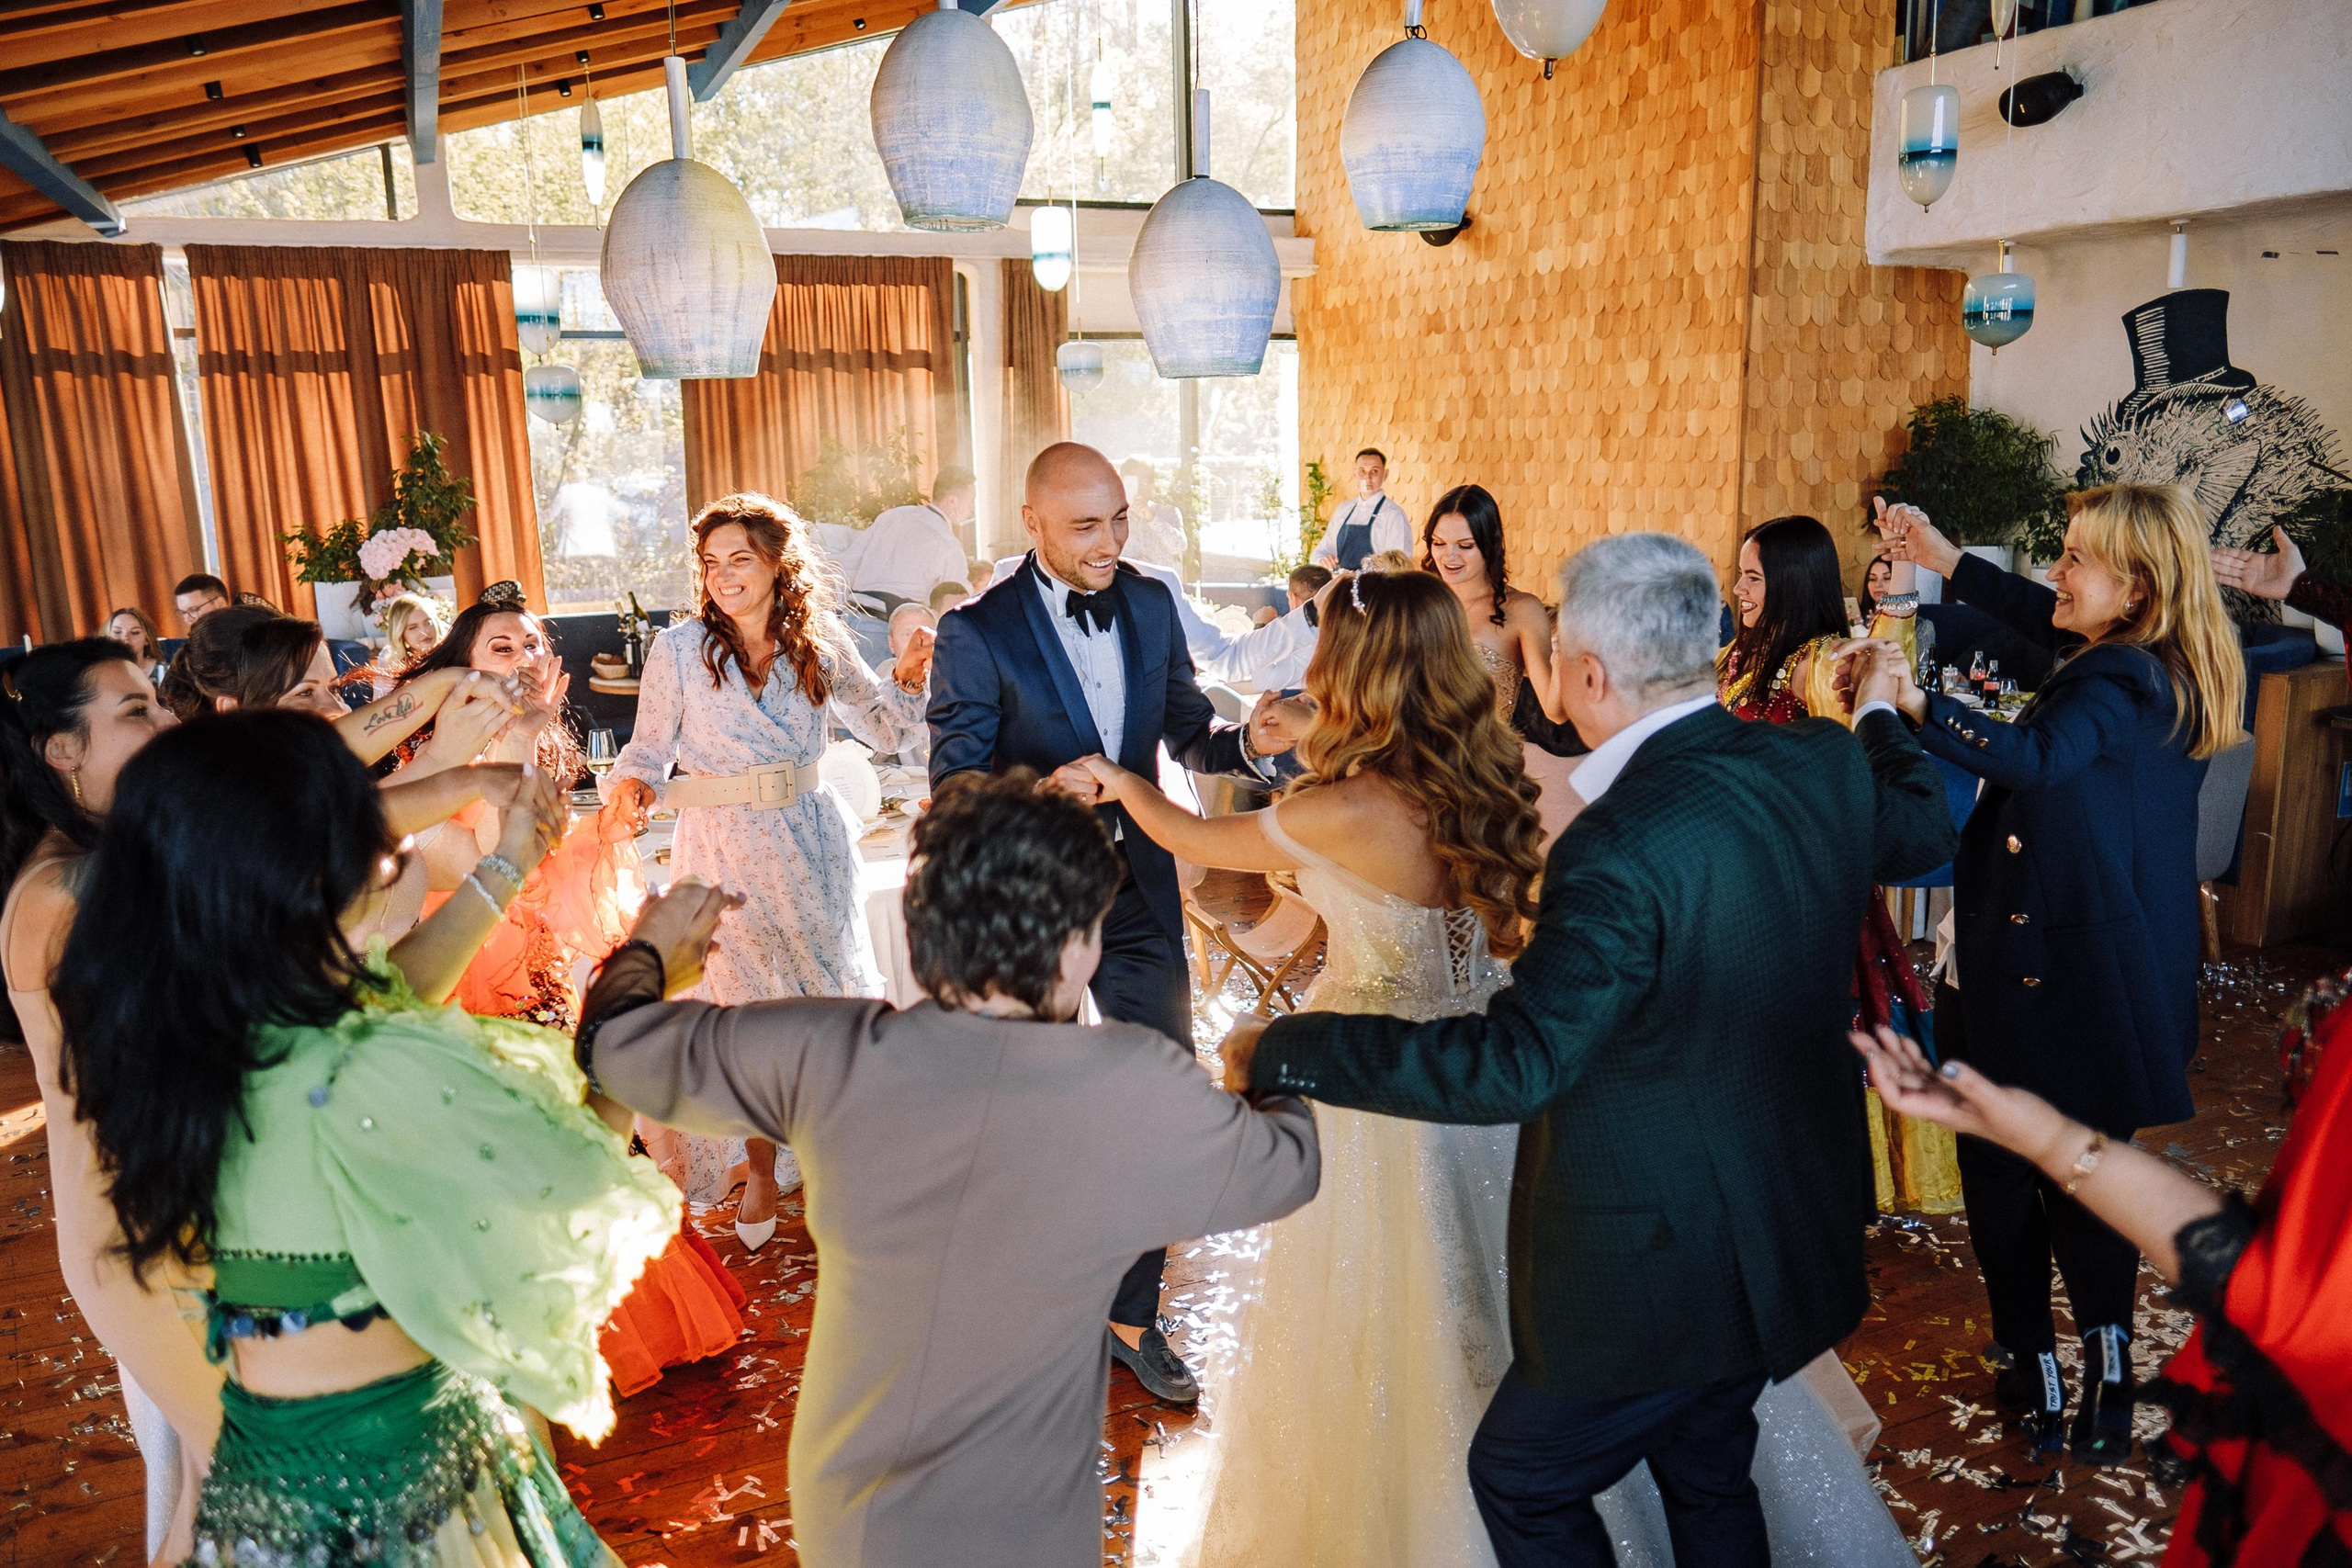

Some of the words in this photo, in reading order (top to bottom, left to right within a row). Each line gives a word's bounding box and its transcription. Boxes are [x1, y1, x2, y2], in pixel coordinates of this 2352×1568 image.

[363, 713, 391, 731] Love
[2042, 1359, 2056, 1380] YOUR
[2048, 1382, 2058, 1408] TRUST
